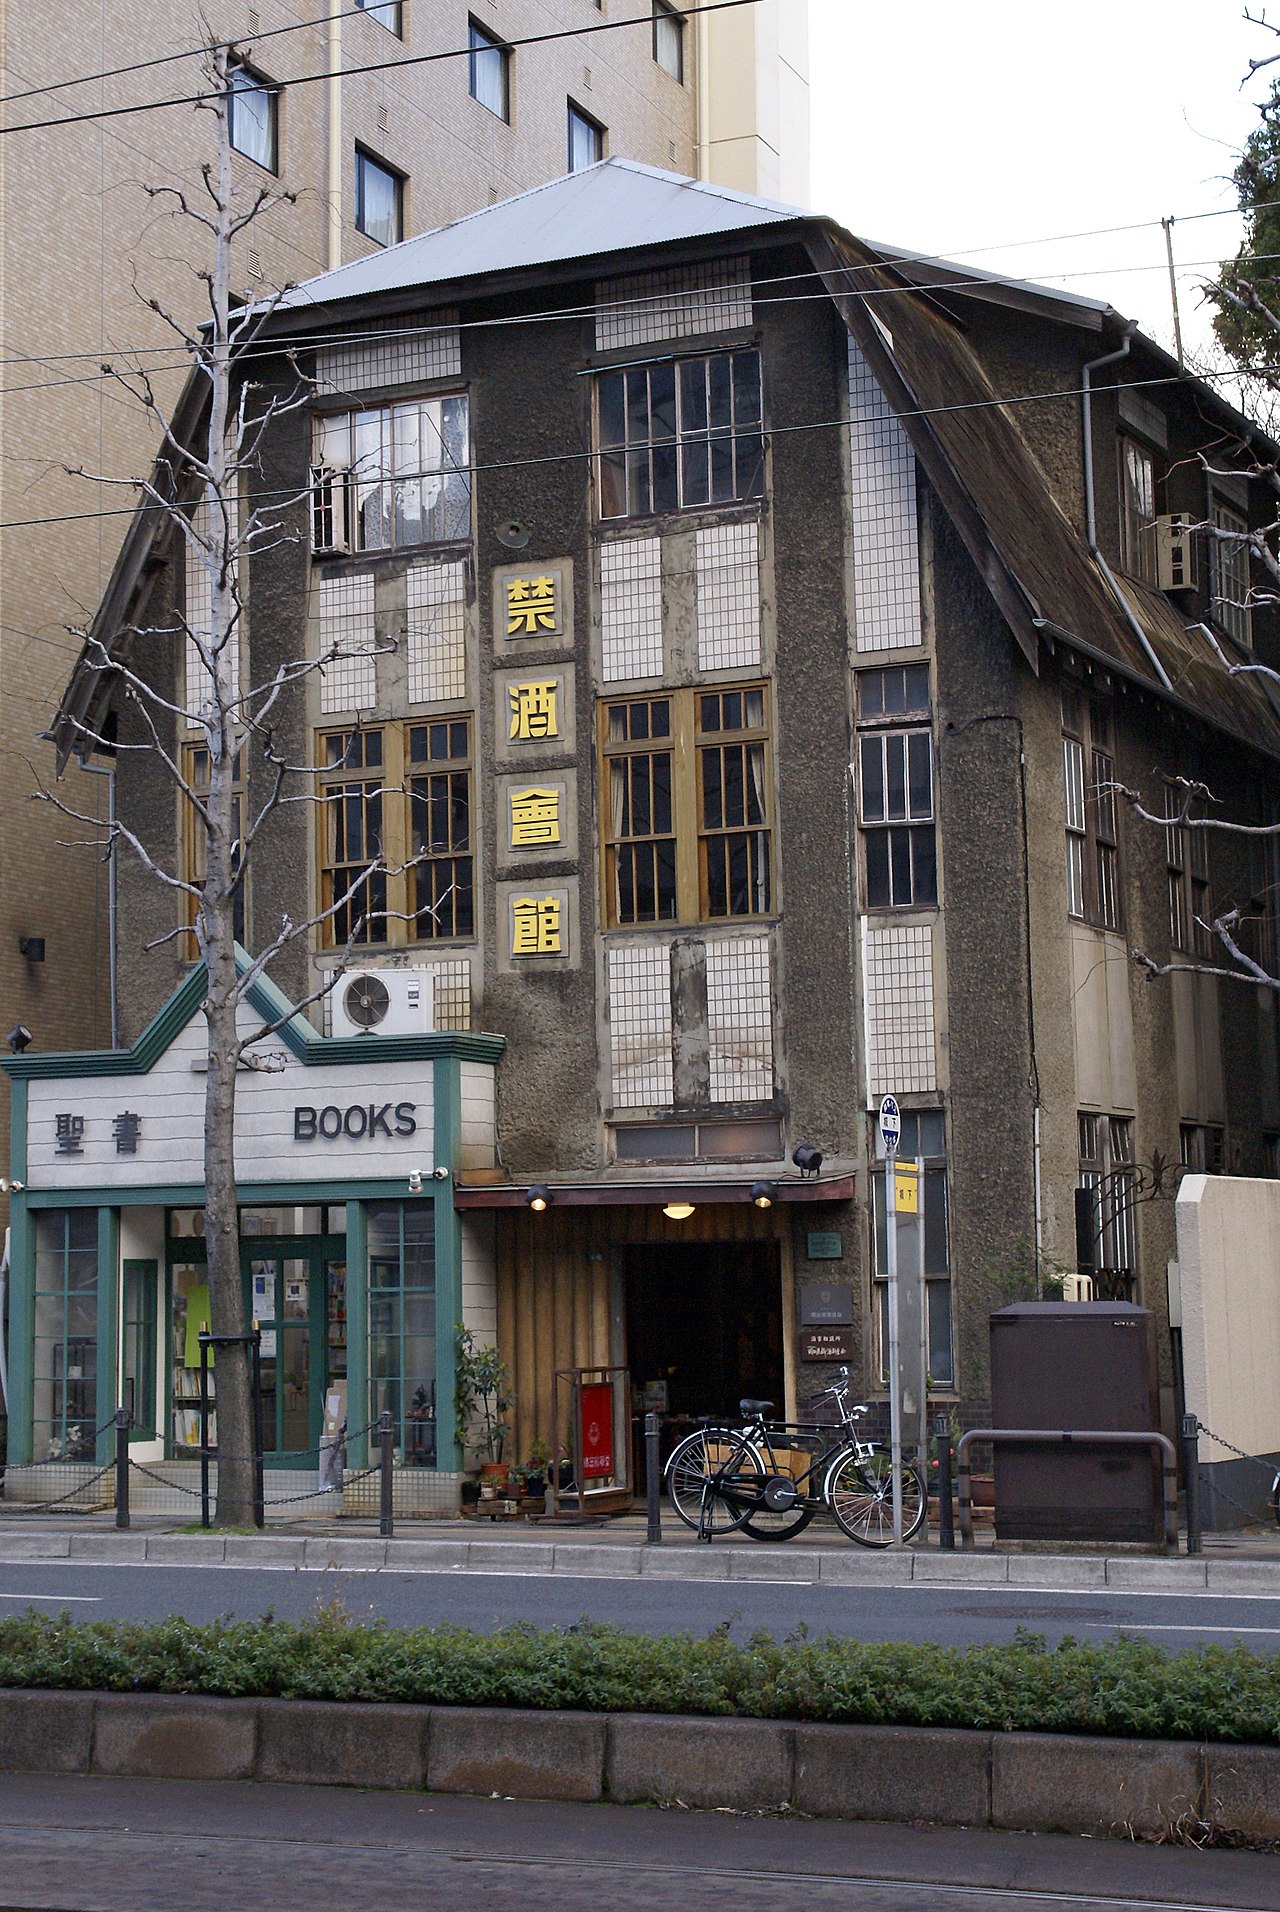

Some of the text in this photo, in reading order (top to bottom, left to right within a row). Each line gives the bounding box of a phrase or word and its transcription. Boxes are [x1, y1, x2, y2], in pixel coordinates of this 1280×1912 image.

[506, 574, 562, 954] 禁酒會館
[54, 1110, 142, 1155] 聖書
[293, 1102, 417, 1141] BOOKS
